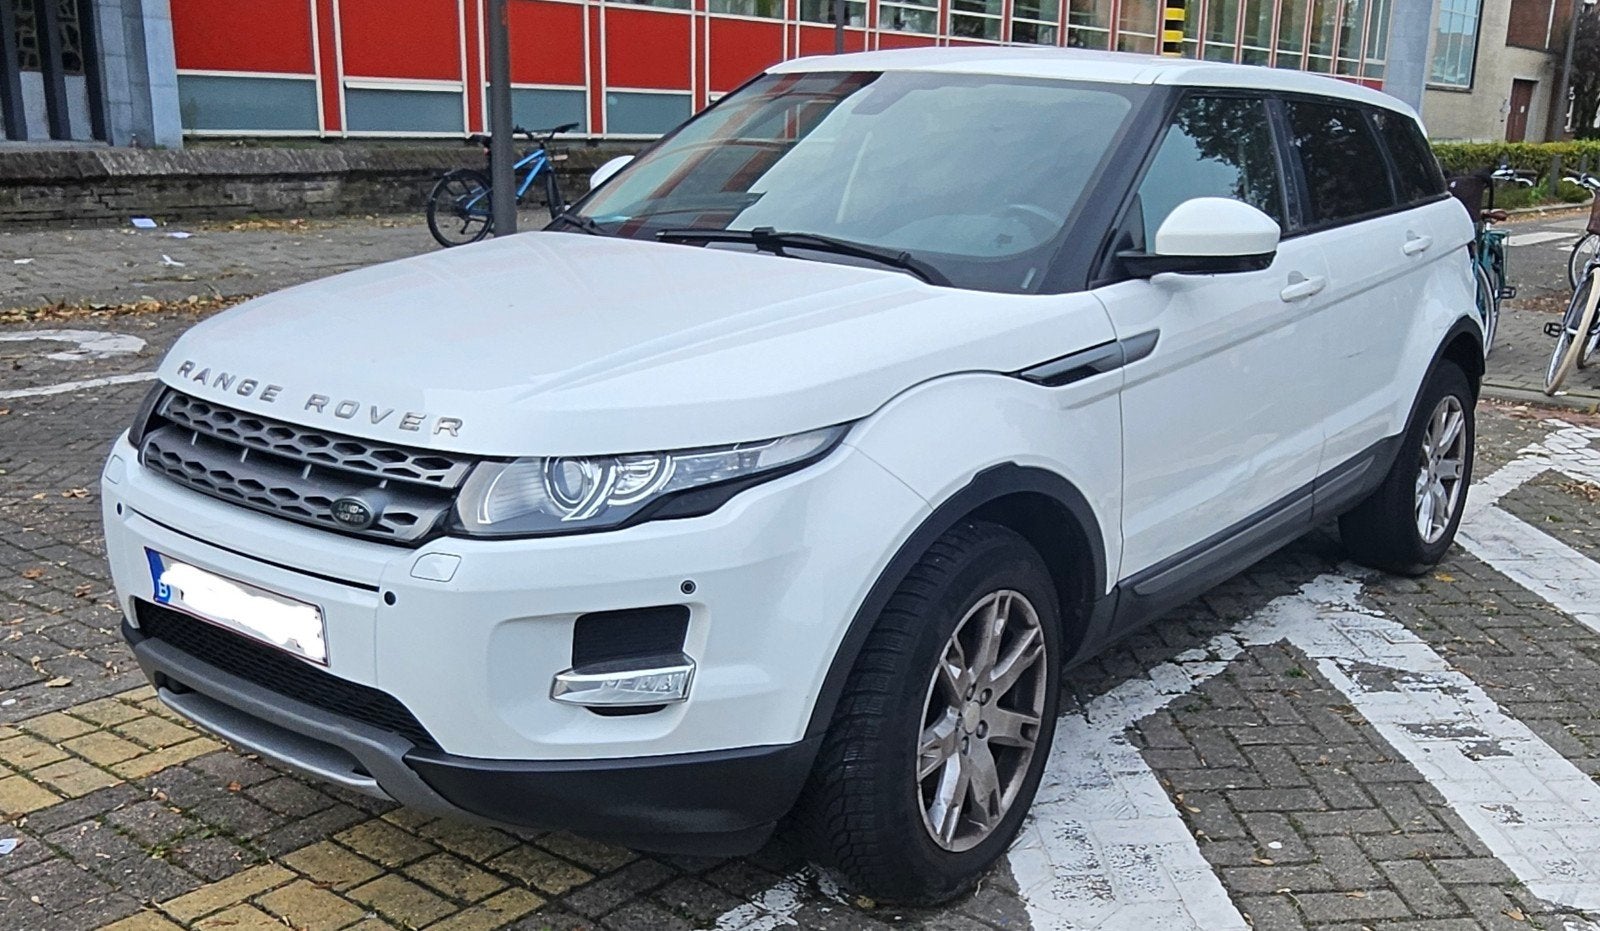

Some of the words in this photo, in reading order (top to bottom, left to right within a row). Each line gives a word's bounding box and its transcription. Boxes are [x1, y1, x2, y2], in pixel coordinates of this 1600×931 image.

[177, 360, 283, 403] RANGE
[304, 393, 464, 437] ROVER
[158, 579, 169, 597] B
